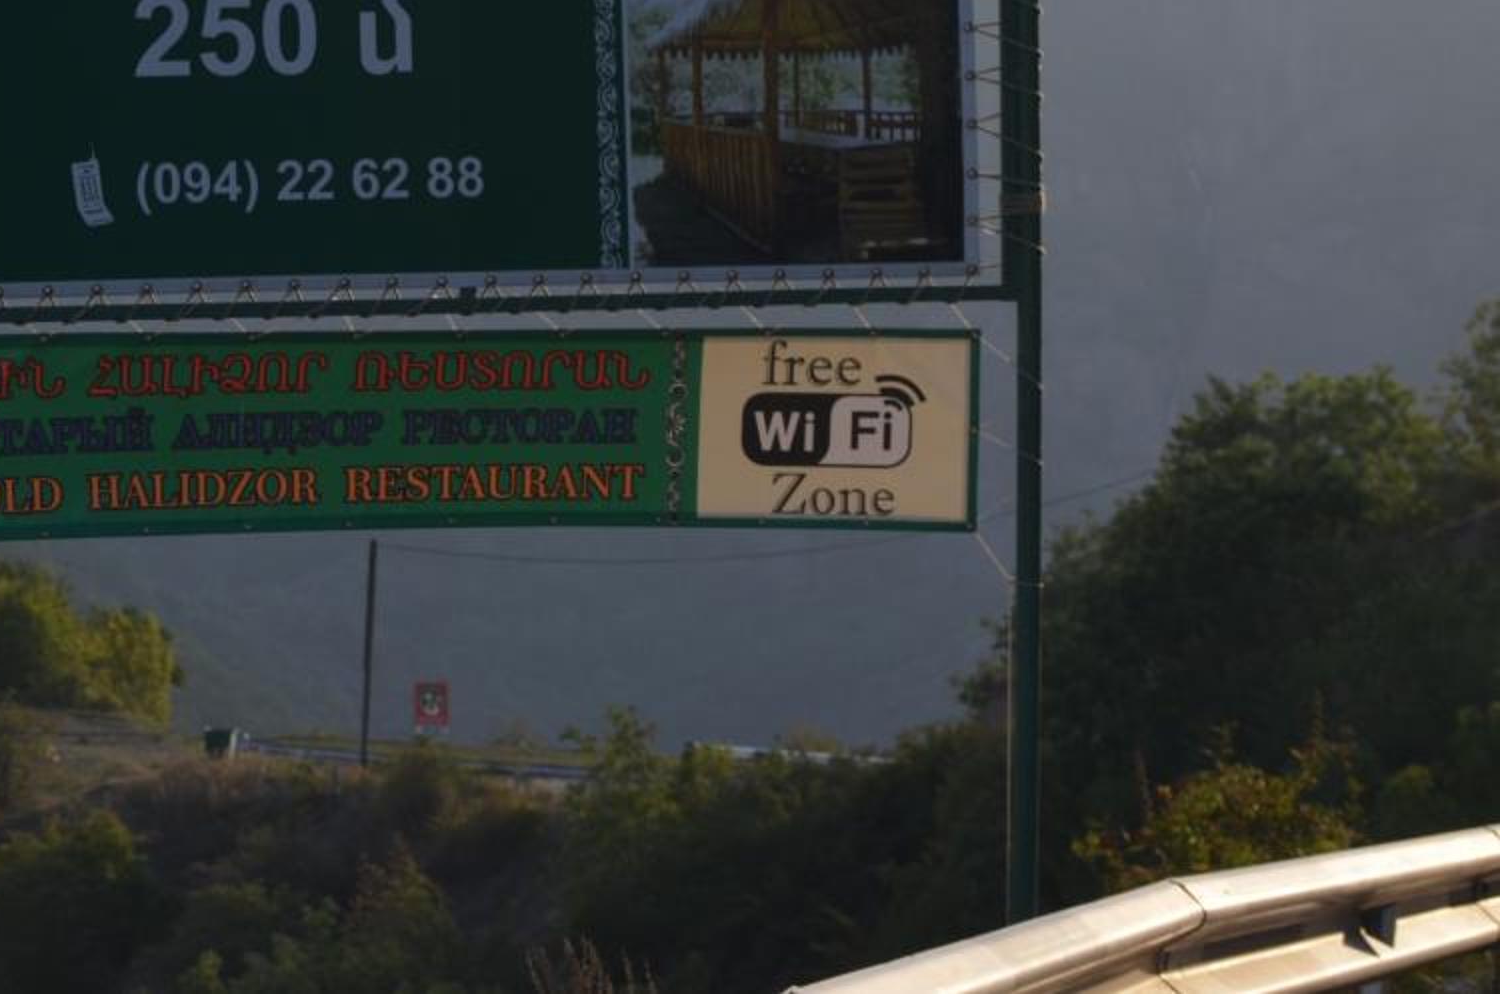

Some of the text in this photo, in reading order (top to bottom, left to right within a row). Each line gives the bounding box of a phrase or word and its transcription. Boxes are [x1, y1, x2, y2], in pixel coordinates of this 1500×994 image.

[138, 157, 483, 214] (094) 22 62 88
[761, 339, 862, 386] free
[399, 407, 638, 445] РЕСТОРАН
[86, 467, 317, 510] HALIDZOR
[346, 462, 645, 503] RESTAURANT
[771, 472, 895, 516] Zone
